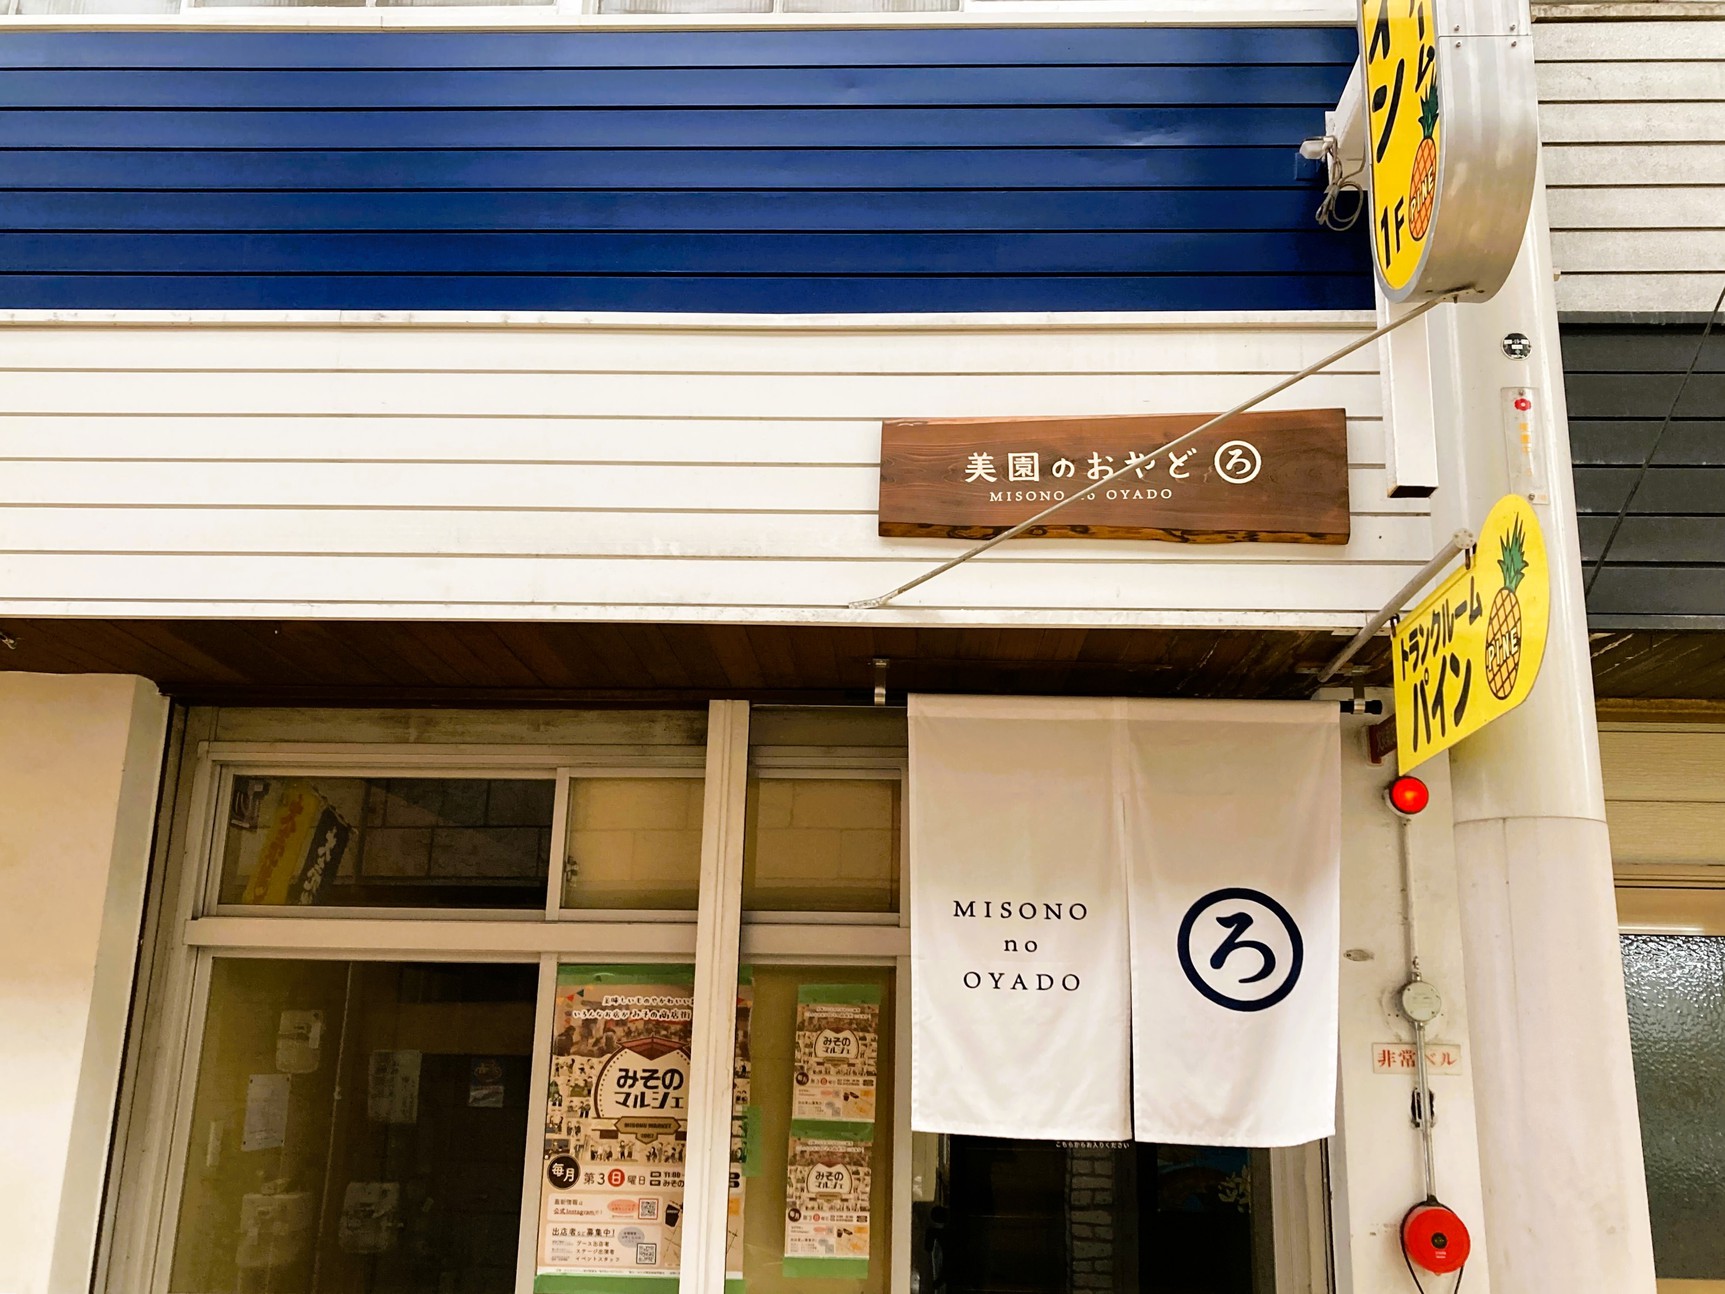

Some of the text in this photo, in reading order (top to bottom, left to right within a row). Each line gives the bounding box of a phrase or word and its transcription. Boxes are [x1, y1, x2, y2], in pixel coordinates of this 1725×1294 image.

[1409, 167, 1435, 223] PINE
[1381, 196, 1405, 269] 1F
[964, 447, 1198, 483] 美園のおやど
[989, 490, 1065, 502] MISONO
[1106, 488, 1173, 501] OYADO
[1401, 575, 1484, 682] トランクルーム
[1486, 626, 1520, 671] PINE
[1412, 652, 1472, 753] パイン
[953, 899, 1088, 921] MISONO
[1003, 938, 1038, 953] no
[963, 970, 1081, 992] OYADO
[1377, 1048, 1457, 1068] 非常ベル
[616, 1068, 684, 1091] みその
[614, 1091, 685, 1110] マルシェ
[551, 1162, 575, 1182] 毎月
